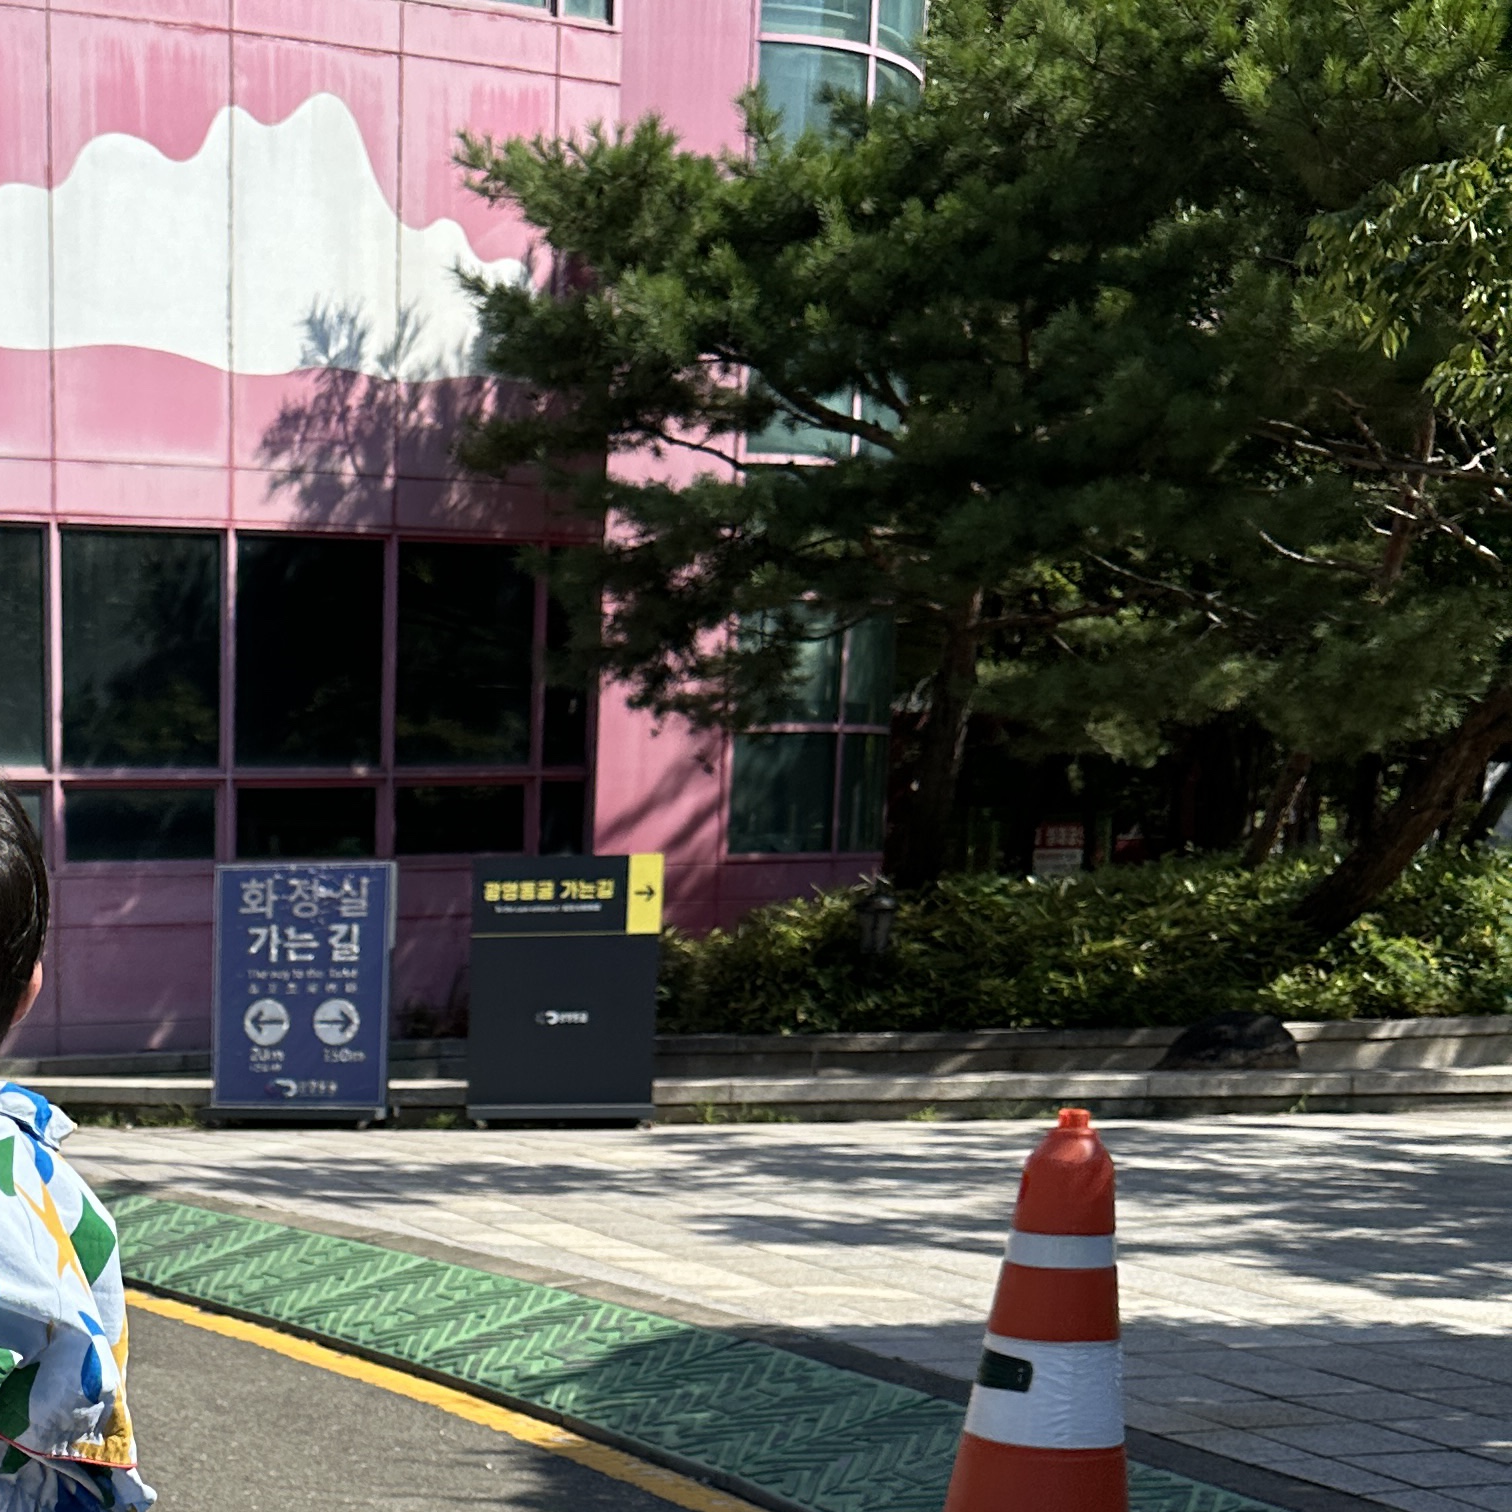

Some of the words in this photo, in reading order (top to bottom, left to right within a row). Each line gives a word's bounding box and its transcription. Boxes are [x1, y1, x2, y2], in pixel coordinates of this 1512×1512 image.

[559, 880, 614, 899] 가는길
[248, 924, 320, 962] 가는
[328, 923, 360, 961] 길
